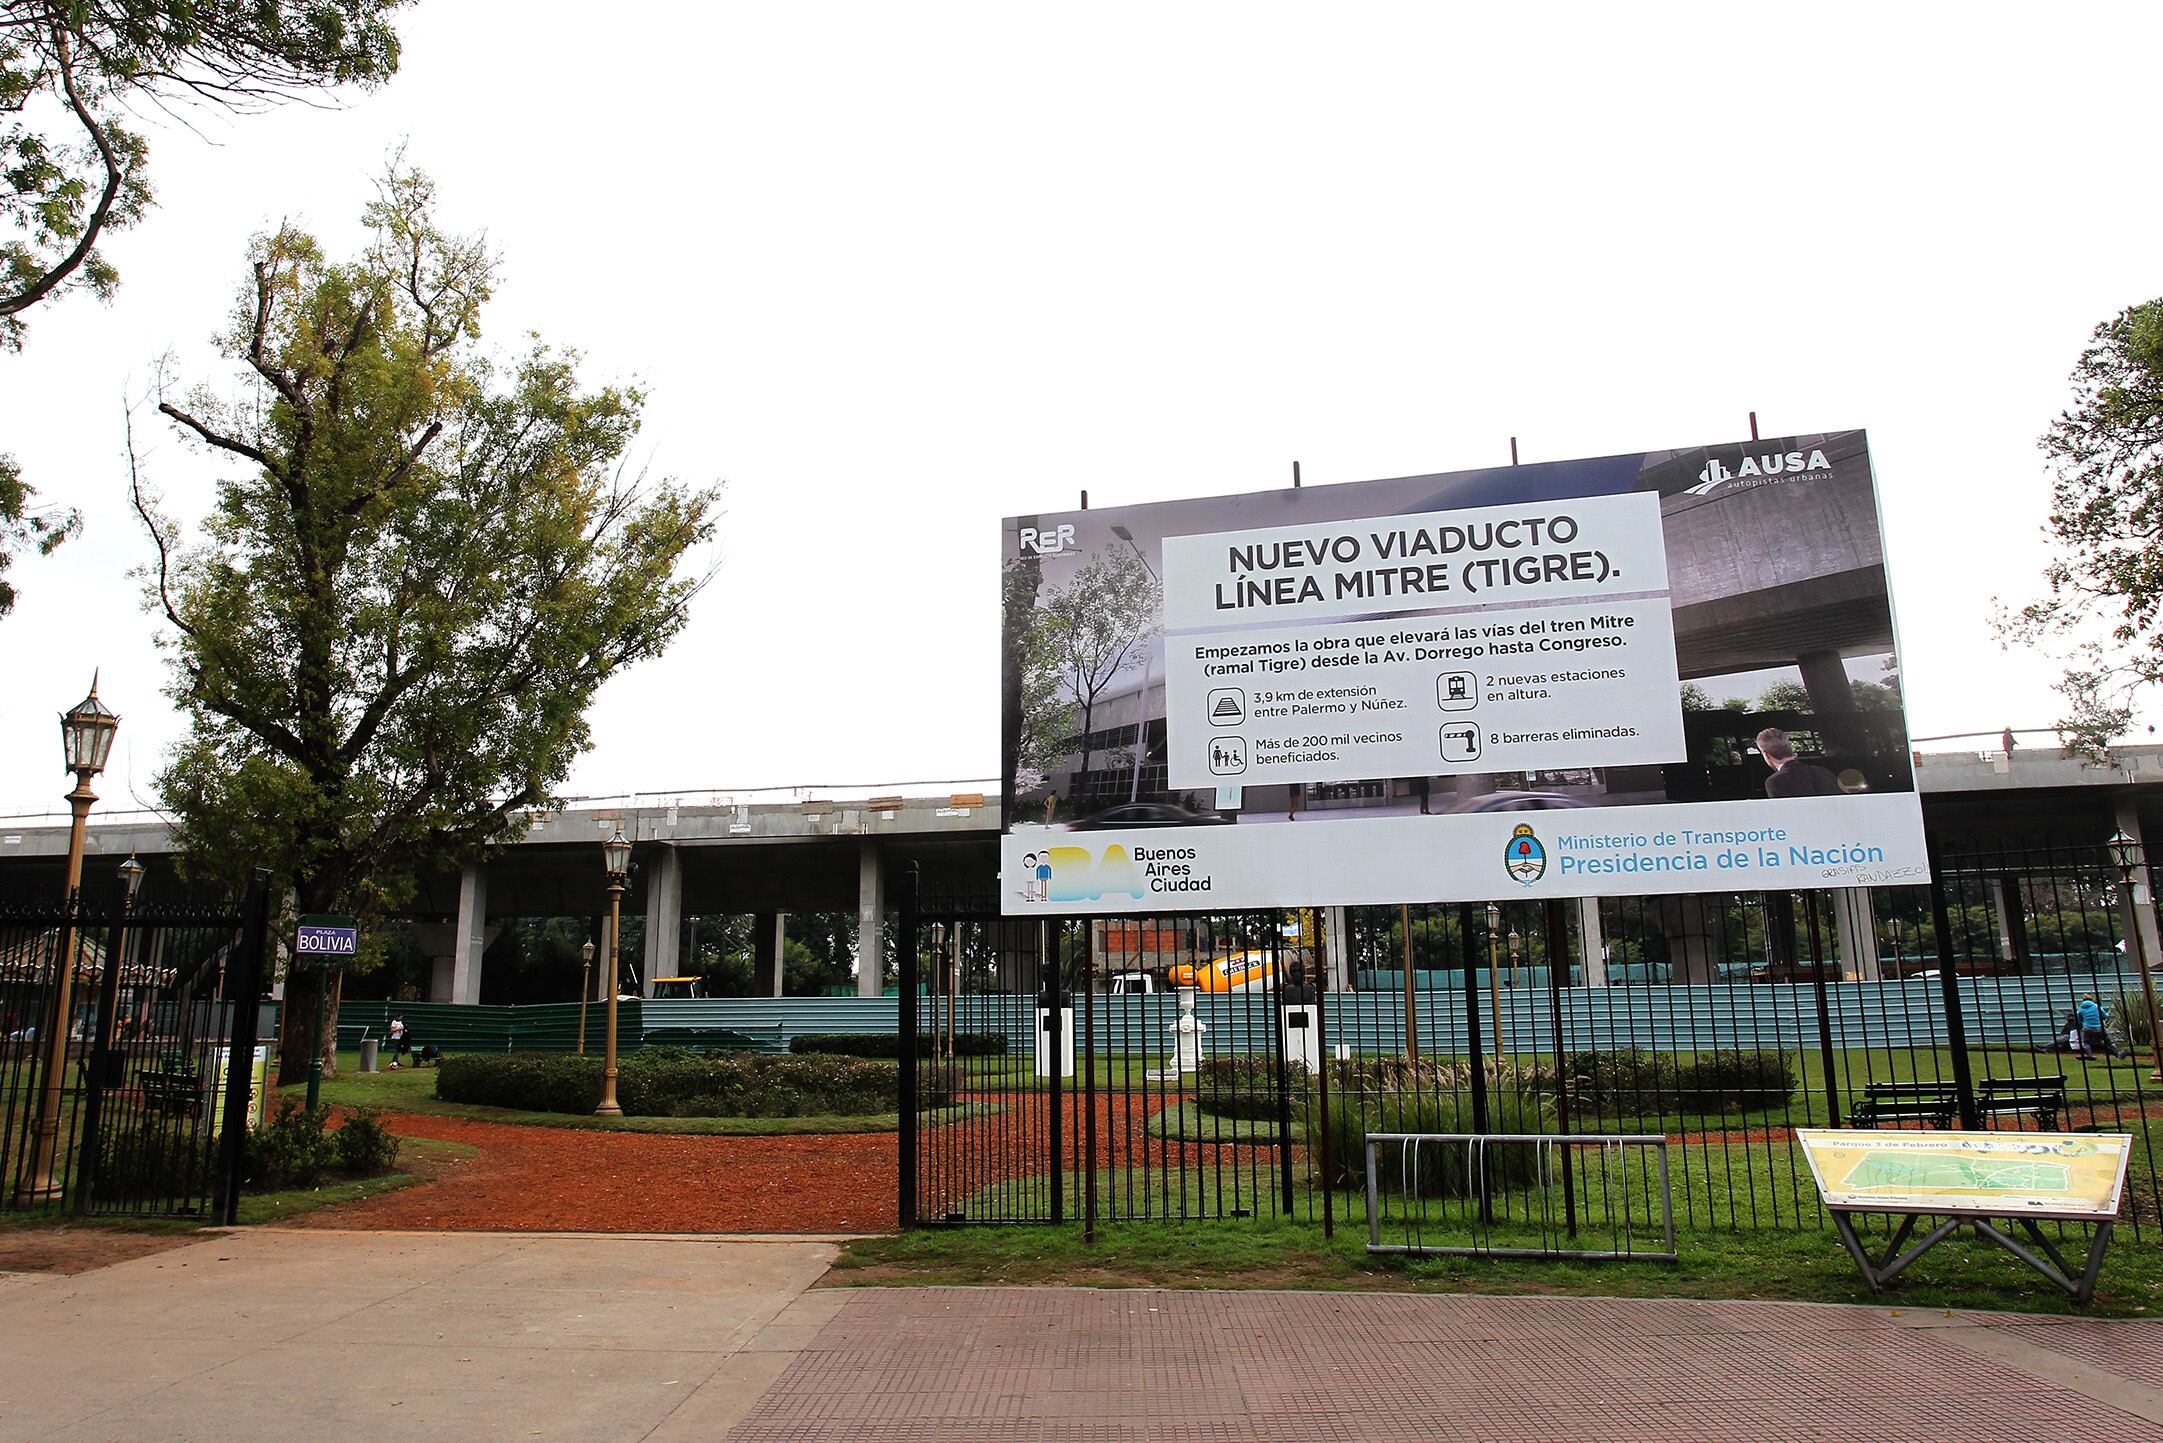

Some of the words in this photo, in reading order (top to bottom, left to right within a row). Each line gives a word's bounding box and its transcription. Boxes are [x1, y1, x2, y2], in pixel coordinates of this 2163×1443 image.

[1738, 450, 1831, 477] AUSA
[1727, 477, 1785, 488] autopistas
[1790, 472, 1834, 482] urbanas
[1020, 524, 1075, 554] RER
[1230, 536, 1360, 573] NUEVO
[1371, 516, 1579, 560] VIADUCTO
[1216, 574, 1325, 610] LÍNEA
[1335, 564, 1449, 600] MITRE
[1462, 551, 1620, 593] (TIGRE).
[1196, 643, 1290, 661] Empezamos
[1295, 639, 1308, 652] la
[1313, 637, 1350, 650] obra
[1355, 636, 1385, 649] que
[1390, 627, 1449, 644] elevará
[1455, 627, 1477, 639] las
[1482, 624, 1515, 637] vías
[1520, 620, 1545, 635] del
[1550, 620, 1585, 632] tren
[1590, 615, 1634, 629] Mitre
[1204, 660, 1253, 677] (ramal
[1258, 657, 1306, 673] Tigre)
[1311, 653, 1359, 668] desde
[1365, 651, 1378, 664] la
[1384, 650, 1410, 663] Av.
[1415, 646, 1484, 660] Dorrego
[1489, 641, 1534, 655] hasta
[1539, 636, 1627, 651] Congreso.
[1486, 676, 1494, 686] 2
[1499, 674, 1547, 686] nuevas
[1551, 669, 1625, 682] estaciones
[1254, 692, 1273, 704] 3,9
[1276, 691, 1295, 702] km
[1298, 689, 1314, 700] de
[1316, 686, 1376, 699] extensión
[1487, 693, 1504, 701] en
[1508, 689, 1551, 700] altura.
[1254, 707, 1288, 718] entre
[1292, 704, 1346, 715] Palermo
[1349, 703, 1357, 714] y
[1362, 699, 1407, 710] Núñez.
[1256, 738, 1280, 750] Más
[1283, 737, 1299, 748] de
[1302, 735, 1328, 747] 200
[1331, 734, 1350, 745] mil
[1353, 732, 1402, 744] vecinos
[1490, 733, 1499, 744] 8
[1503, 732, 1559, 743] barreras
[1562, 726, 1639, 740] eliminadas.
[1256, 750, 1339, 764] beneficiados.
[1558, 833, 1647, 850] Ministerio
[1653, 832, 1676, 846] de
[1681, 828, 1786, 845] Transporte
[1134, 847, 1196, 861] Buenos
[1560, 850, 1707, 874] Presidencia
[1717, 849, 1749, 868] de
[1758, 847, 1780, 867] la
[1789, 842, 1883, 866] Nación
[1145, 862, 1191, 876] Aires
[1151, 876, 1211, 892] Ciudad
[300, 935, 353, 951] BOLIVIA
